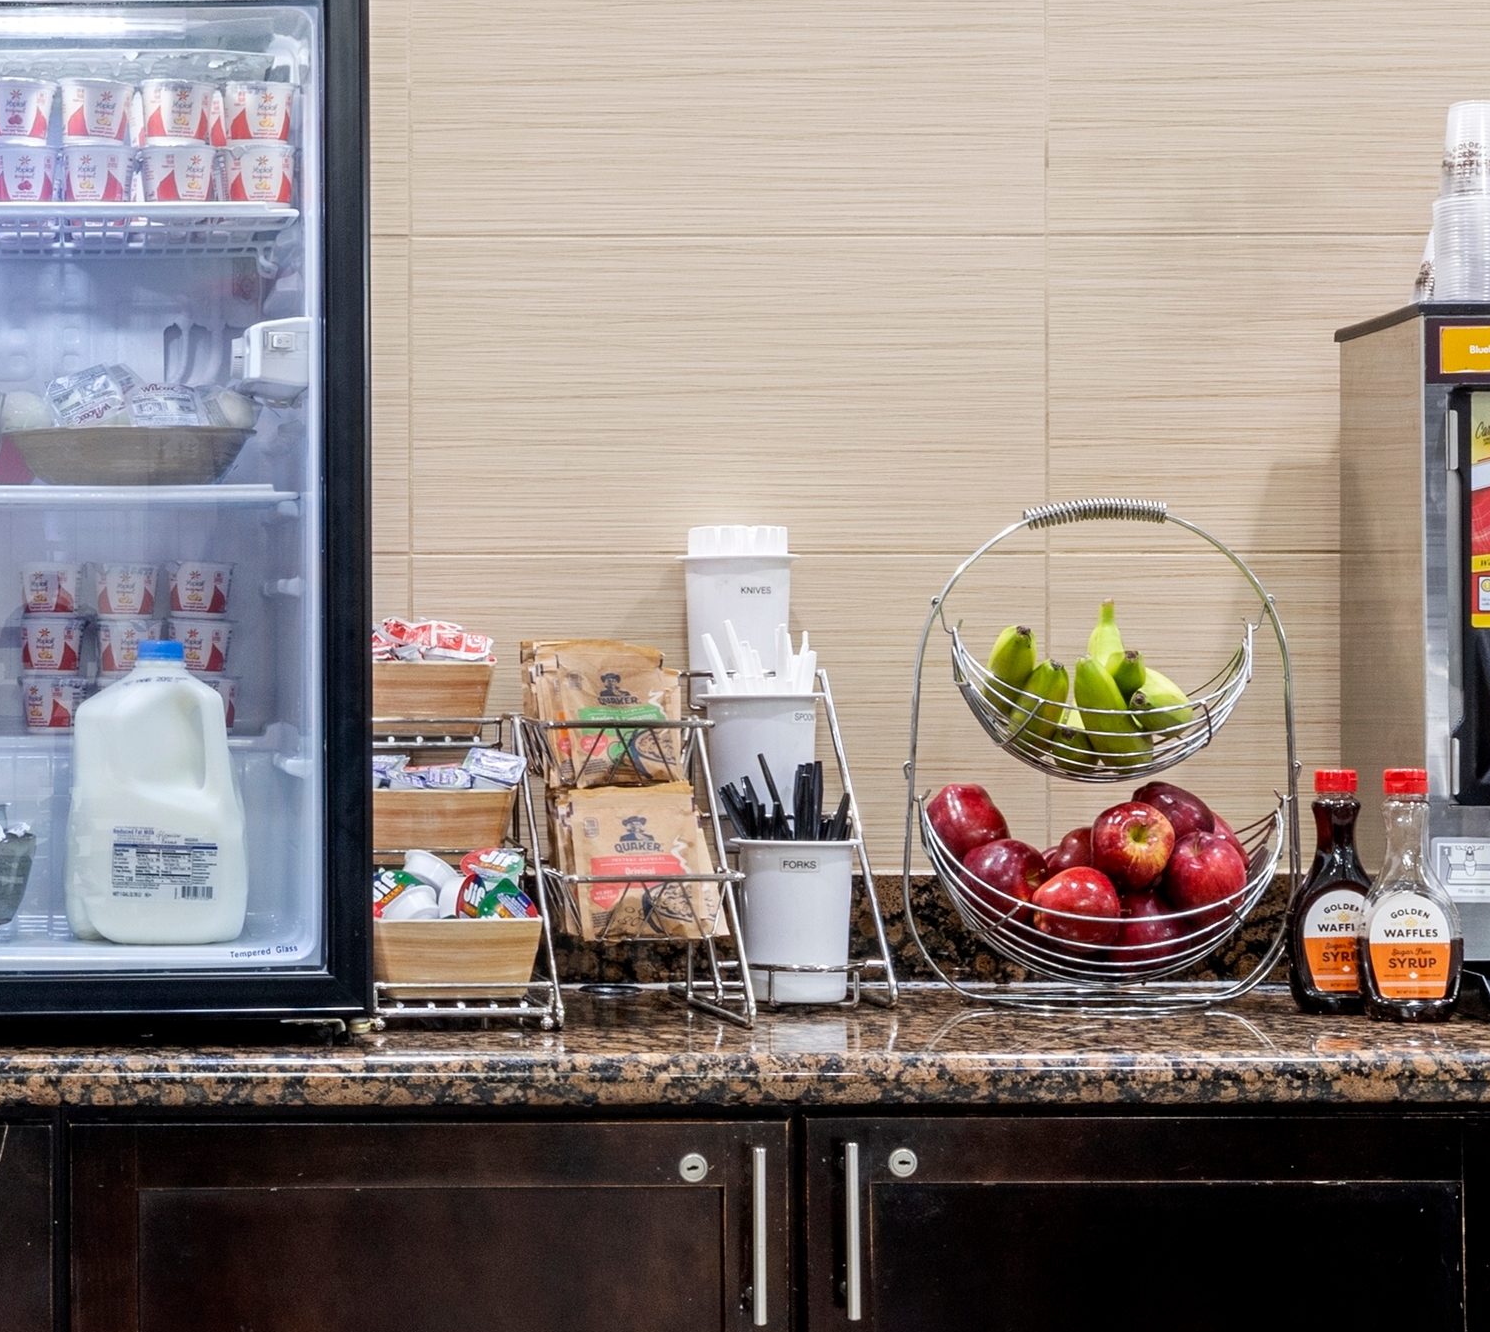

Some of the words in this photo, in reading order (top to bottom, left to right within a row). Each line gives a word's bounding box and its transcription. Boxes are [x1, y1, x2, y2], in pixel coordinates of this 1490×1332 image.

[740, 586, 771, 595] KNIVES
[597, 696, 639, 705] QUAKER
[614, 842, 662, 853] QUAKER
[479, 850, 519, 867] Jif
[783, 860, 817, 869] FORKS
[625, 867, 655, 875] Original
[463, 882, 486, 907] Jif
[1390, 908, 1430, 920] GOLDEN
[1384, 928, 1438, 938] WAFFLES
[230, 947, 271, 958] Tempered
[275, 945, 298, 954] Glass
[1392, 948, 1414, 956] Sugar
[1389, 958, 1437, 968] SYRUP
